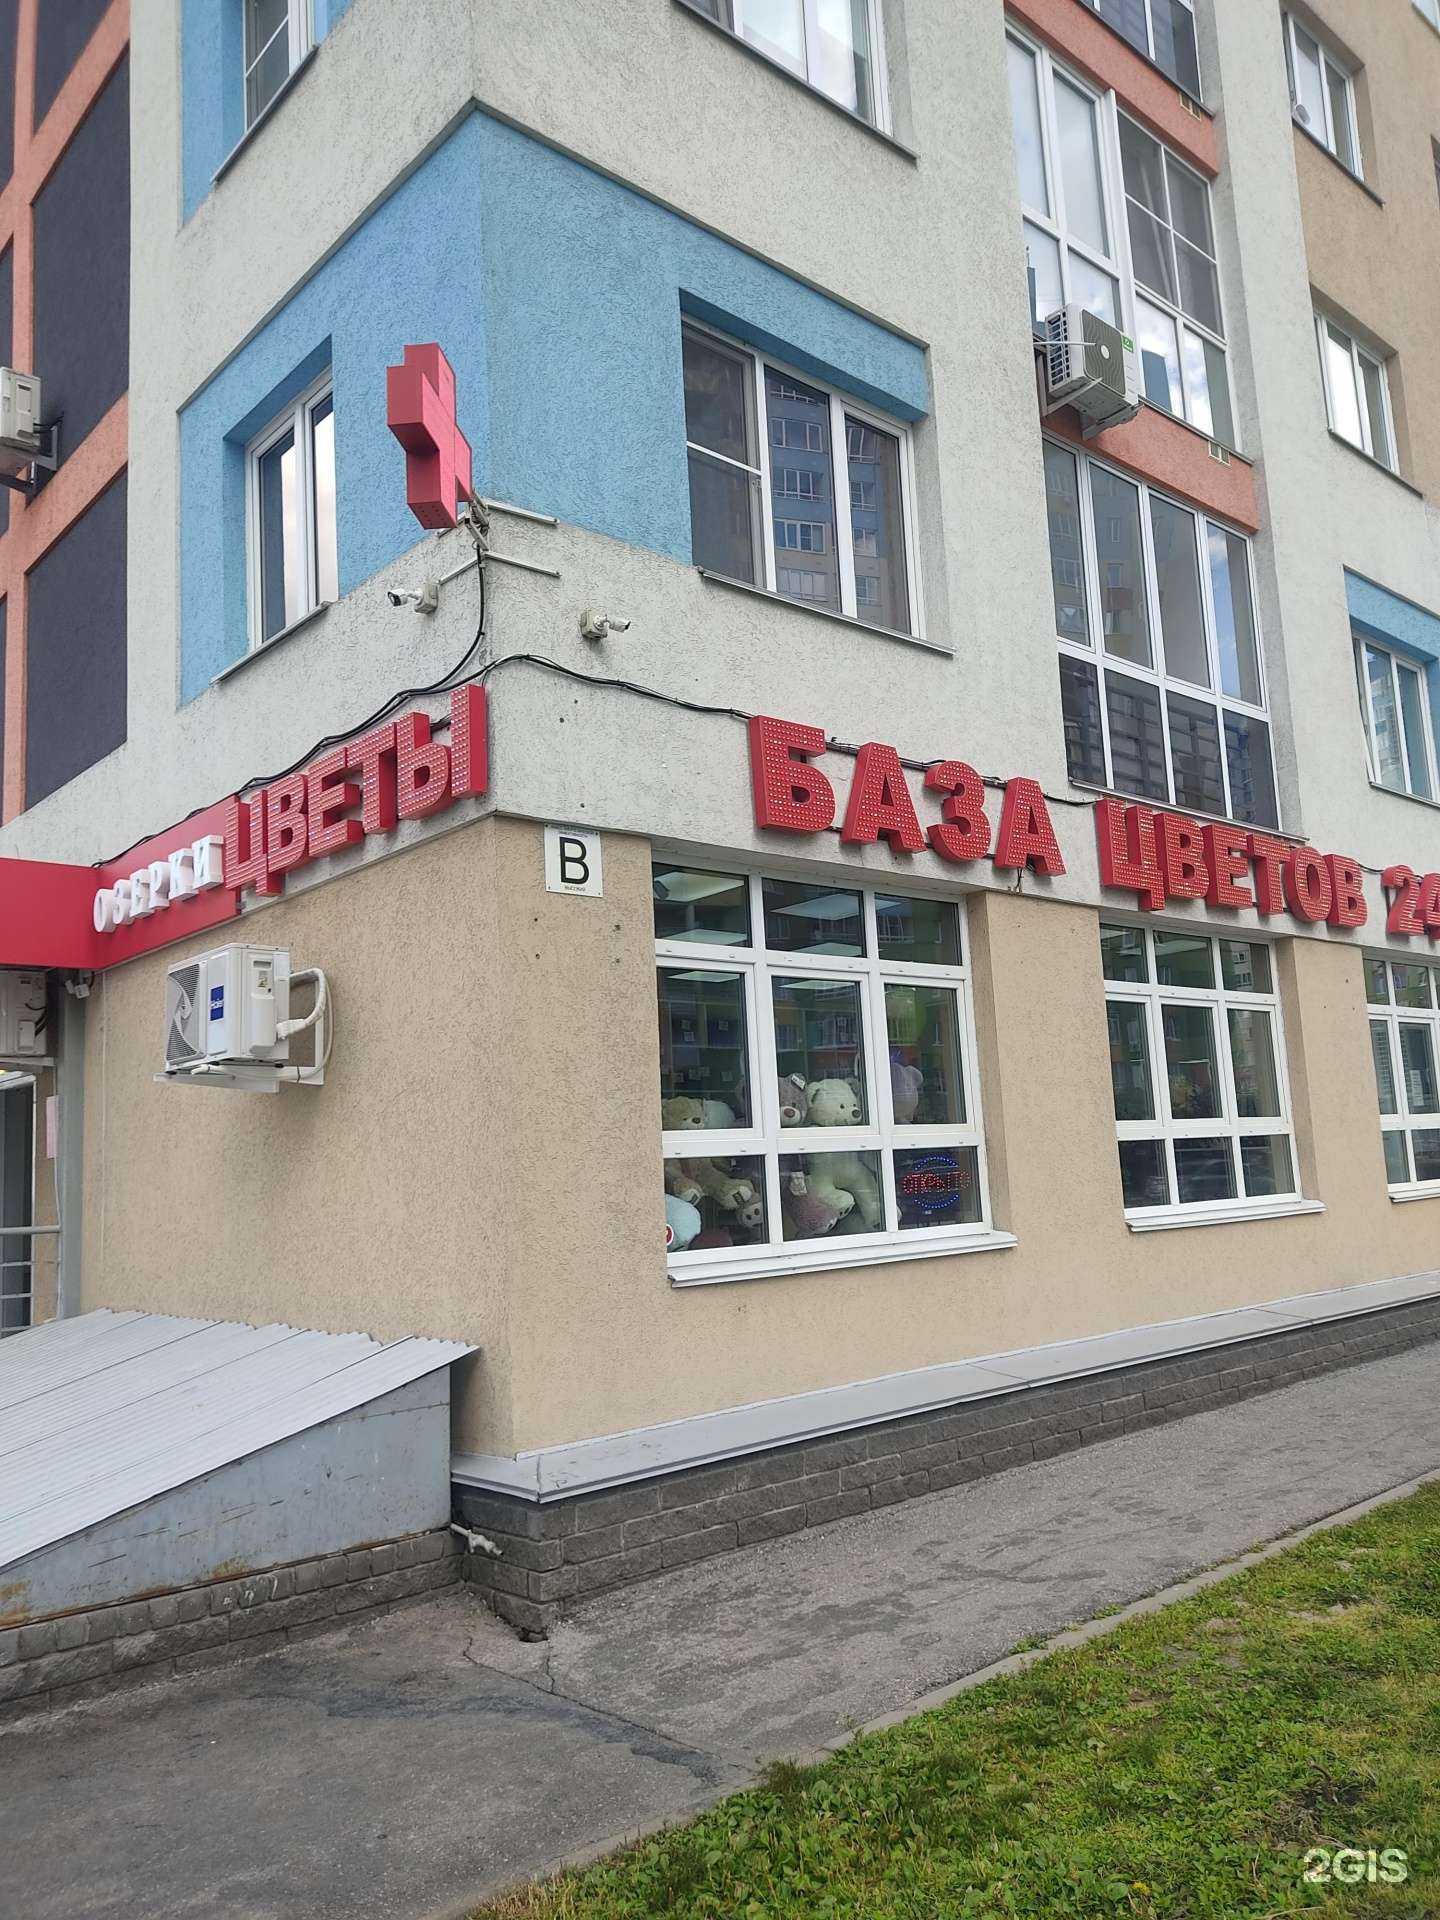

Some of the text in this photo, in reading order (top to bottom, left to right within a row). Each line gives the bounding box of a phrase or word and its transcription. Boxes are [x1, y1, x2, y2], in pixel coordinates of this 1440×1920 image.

[225, 683, 488, 897] ЦВЕТЫ
[559, 836, 590, 885] В
[748, 714, 1067, 877] БАЗА
[1095, 798, 1368, 928] ЦВЕТОВ
[93, 834, 224, 933] ОЗЕРКИ
